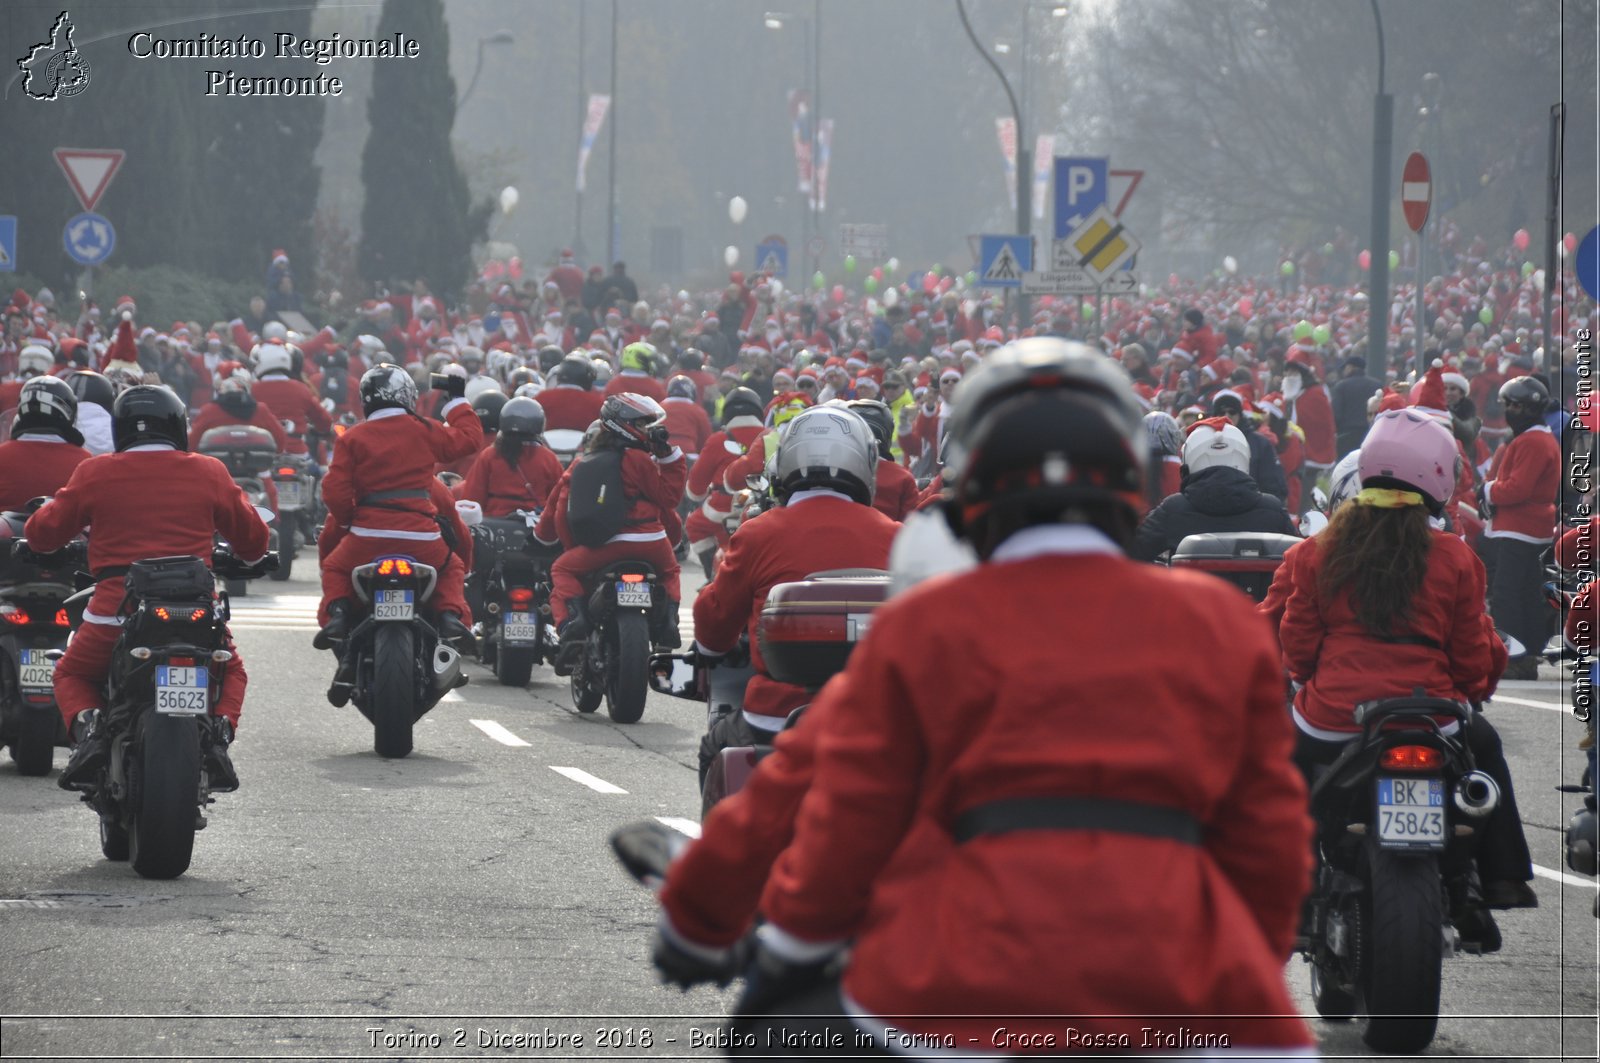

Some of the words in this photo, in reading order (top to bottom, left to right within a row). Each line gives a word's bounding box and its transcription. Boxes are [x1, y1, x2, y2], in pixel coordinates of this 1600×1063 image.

[1068, 166, 1096, 206] P
[384, 590, 399, 603] DF
[618, 593, 650, 605] 32234
[376, 605, 412, 618] 62017
[511, 612, 523, 624] CK
[505, 625, 535, 638] 94669
[29, 650, 46, 666] DH
[169, 668, 188, 685] EJ
[159, 690, 205, 710] 36623
[1394, 781, 1418, 805] BK
[1430, 793, 1442, 805] TO
[1382, 811, 1442, 836] 75843
